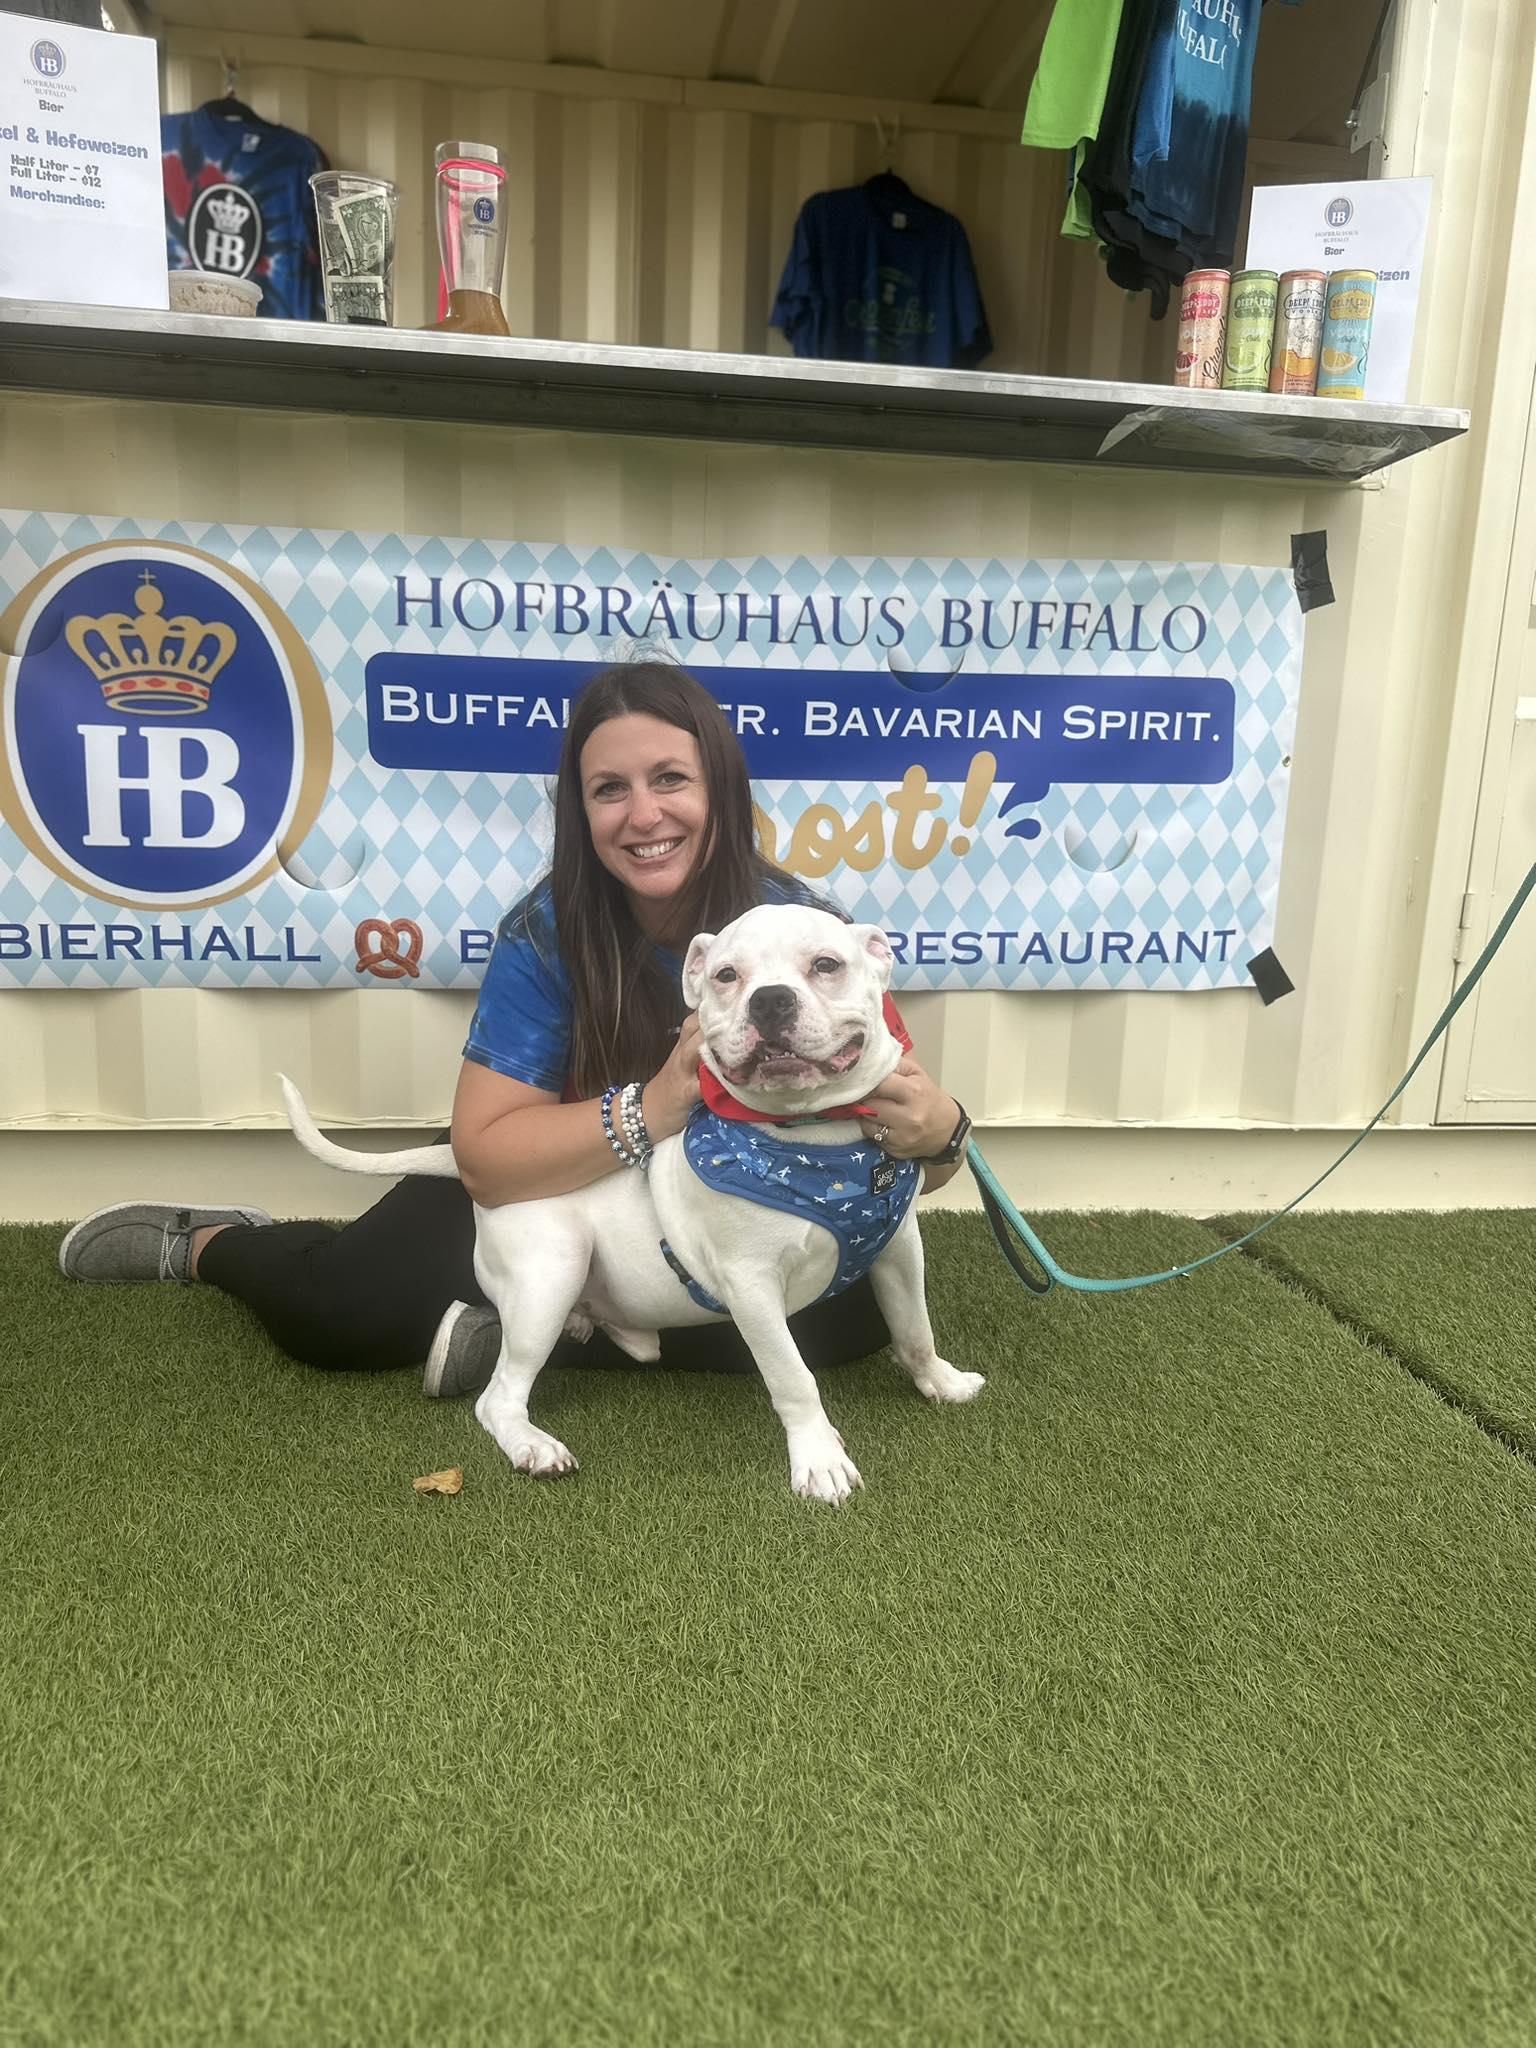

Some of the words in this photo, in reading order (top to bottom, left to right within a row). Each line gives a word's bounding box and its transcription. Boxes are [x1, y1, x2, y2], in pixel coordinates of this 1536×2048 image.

[40, 56, 58, 73] HB
[38, 99, 65, 113] Bier
[26, 127, 40, 144] &
[46, 130, 149, 159] Hefeweizen
[10, 166, 32, 179] Full
[36, 169, 66, 184] Liter
[11, 154, 35, 168] Half
[39, 158, 69, 173] Liter
[10, 185, 105, 209] Merchandise:
[1332, 210, 1346, 224] HB
[203, 229, 245, 272] HB
[1324, 246, 1345, 256] Bier
[394, 574, 906, 648] HOFBRÄUHAUS
[938, 598, 1208, 654] BUFFALO
[804, 700, 1043, 740] BAVARIAN
[1061, 704, 1222, 742] SPIRIT.
[76, 723, 246, 849] HB
[0, 923, 323, 964] BIERHALL
[886, 929, 1237, 966] RESTAURANT
